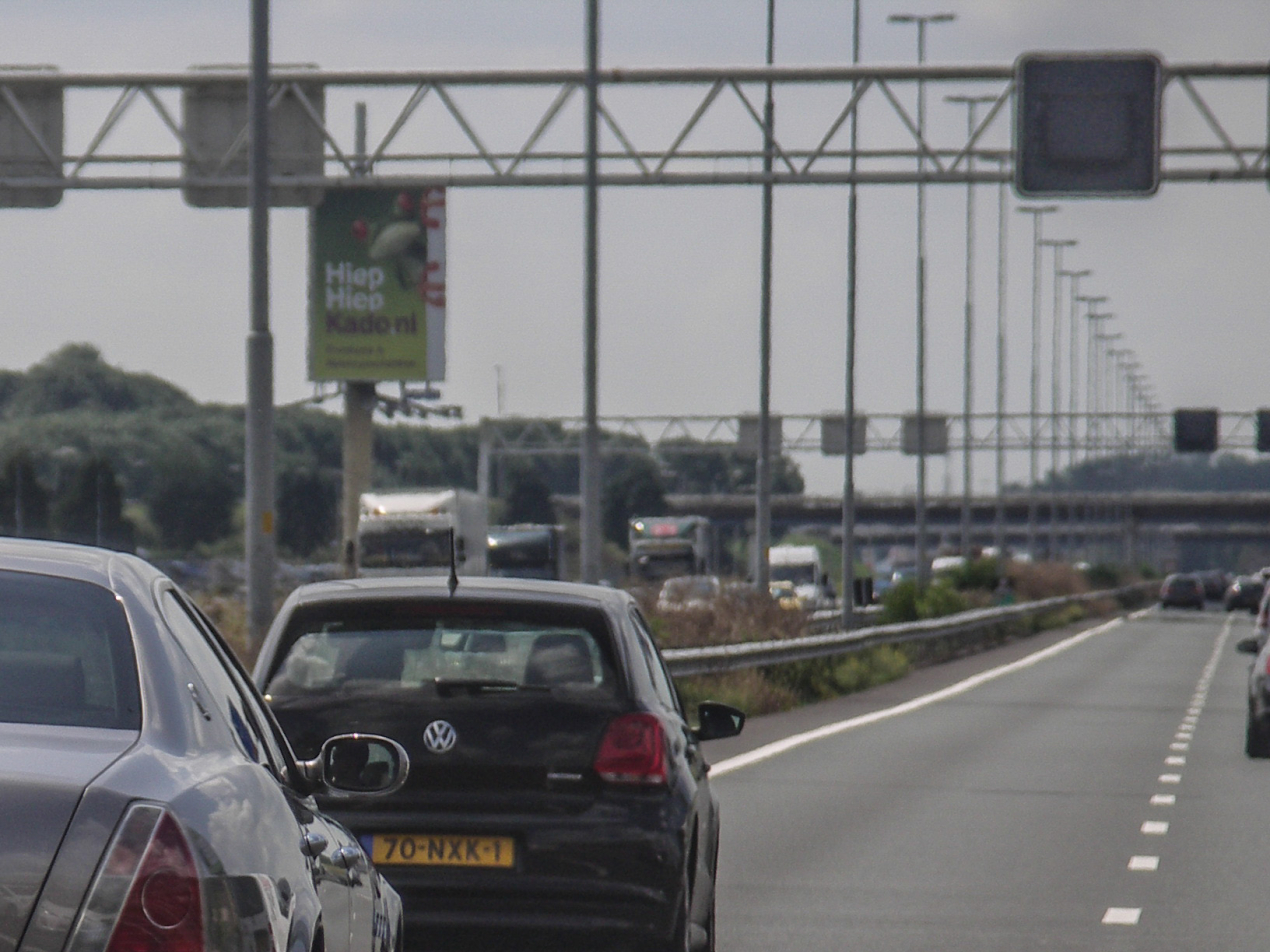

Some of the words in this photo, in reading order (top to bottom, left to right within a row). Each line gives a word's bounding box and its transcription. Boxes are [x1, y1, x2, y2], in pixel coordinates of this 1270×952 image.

[325, 260, 385, 292] Hiep
[325, 285, 385, 314] Hiep
[325, 311, 418, 335] Kado.nl
[383, 837, 501, 862] 70-NXK-1
